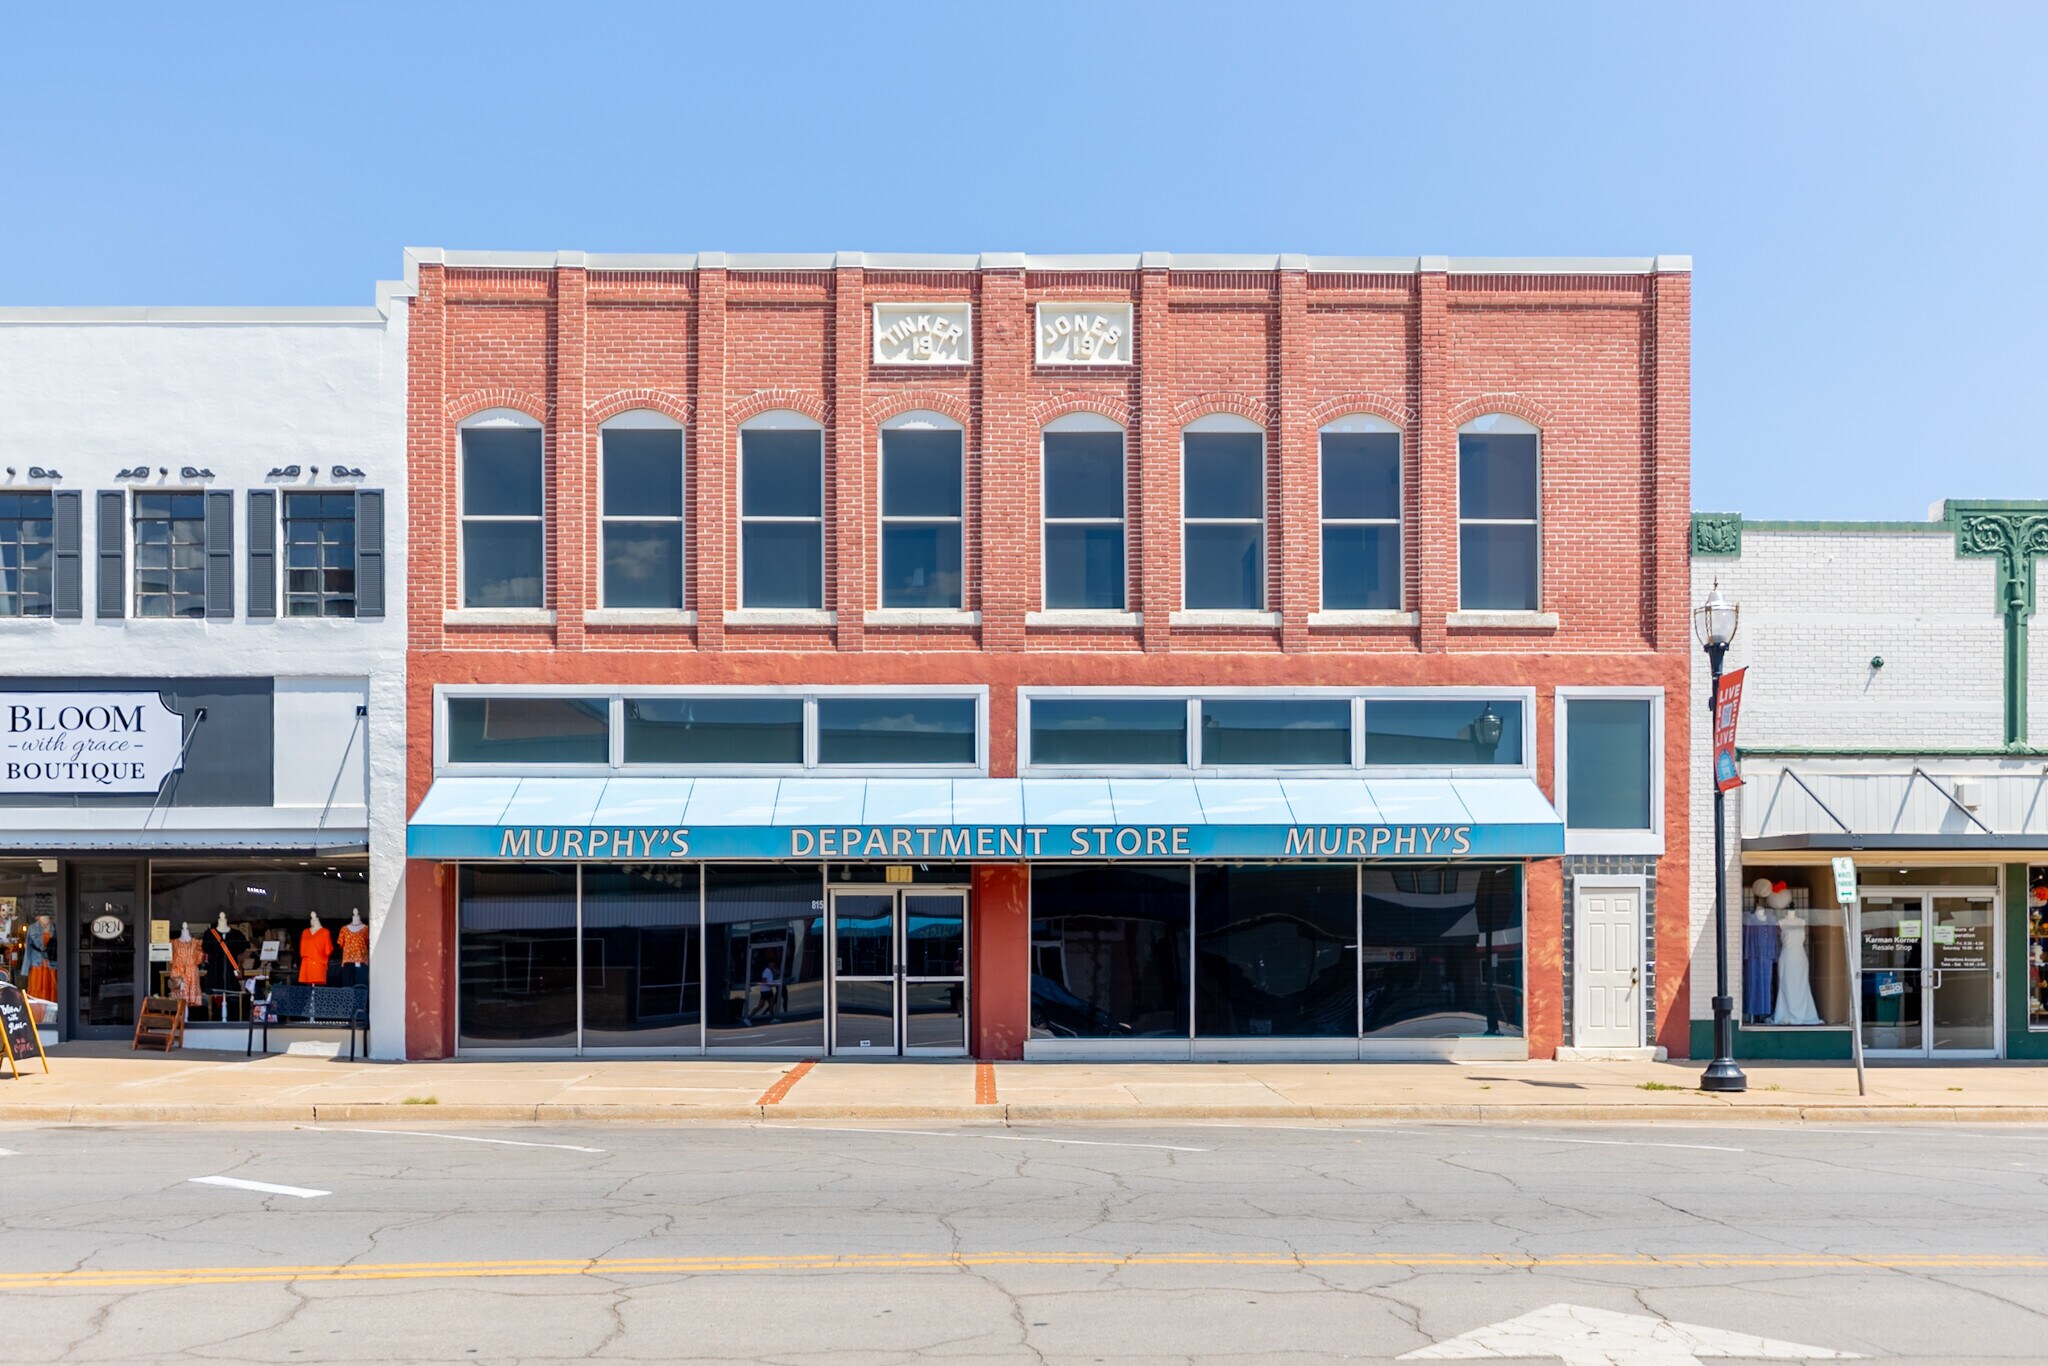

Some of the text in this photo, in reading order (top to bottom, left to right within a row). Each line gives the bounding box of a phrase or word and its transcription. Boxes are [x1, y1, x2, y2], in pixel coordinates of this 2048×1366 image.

[881, 315, 963, 347] TINKER
[1045, 314, 1122, 345] JONES
[912, 336, 933, 355] 19
[1073, 336, 1094, 355] 19
[1719, 683, 1741, 703] LIVE
[7, 705, 146, 732] BLOOM
[22, 732, 130, 761] with grace
[1715, 729, 1735, 747] LIVE
[6, 762, 145, 784] BOUTIQUE
[499, 828, 690, 857] MURPHY'S
[790, 827, 1191, 857] DEPARTMENT STORE
[1284, 826, 1472, 855] MURPHY'S
[811, 900, 824, 910] 815
[92, 921, 120, 933] OPEN
[1895, 944, 1912, 952] Shop
